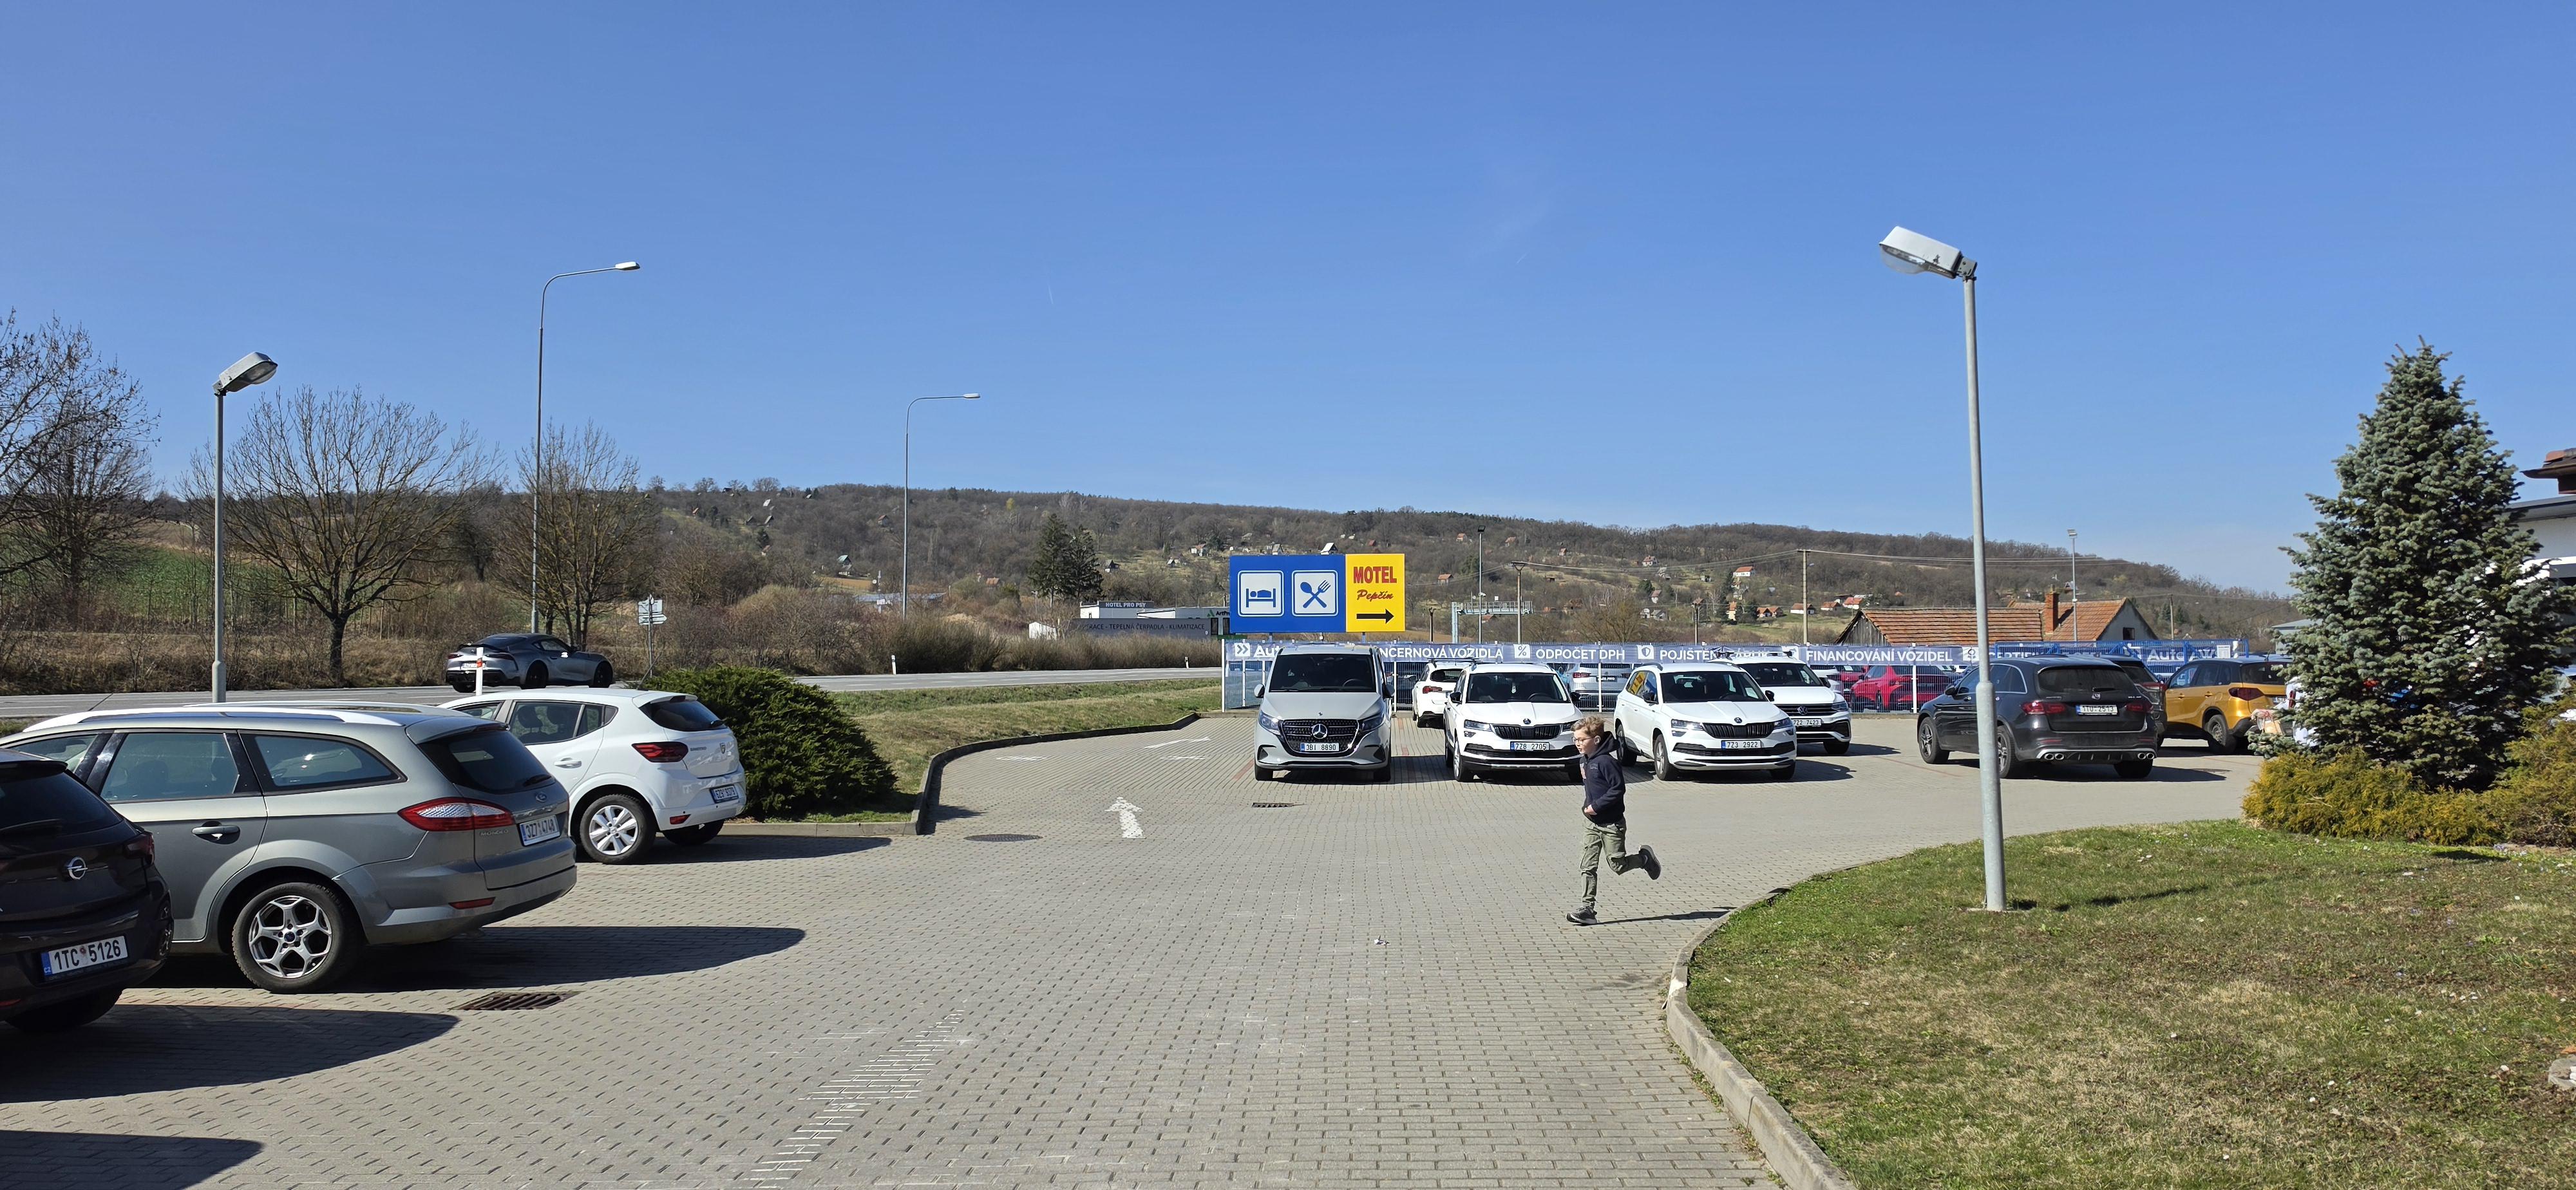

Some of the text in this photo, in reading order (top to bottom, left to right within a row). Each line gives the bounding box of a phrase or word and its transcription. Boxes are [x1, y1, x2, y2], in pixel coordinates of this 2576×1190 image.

[1353, 566, 1397, 583] MOTEL
[1357, 589, 1394, 601] Pepčín
[1254, 646, 1280, 657] Aut
[1379, 645, 1503, 659] NCERNOVÁ VOZIDLA
[1535, 647, 1625, 660] ODPOČET DPH
[1660, 647, 1717, 660] POJIŠTĚN
[1806, 648, 1953, 661] FINANCOVÁNÍ VOZIDEL
[2147, 648, 2184, 660] Auto
[526, 818, 555, 838] 3Z7 4748
[54, 940, 121, 970] 1TC 5126
